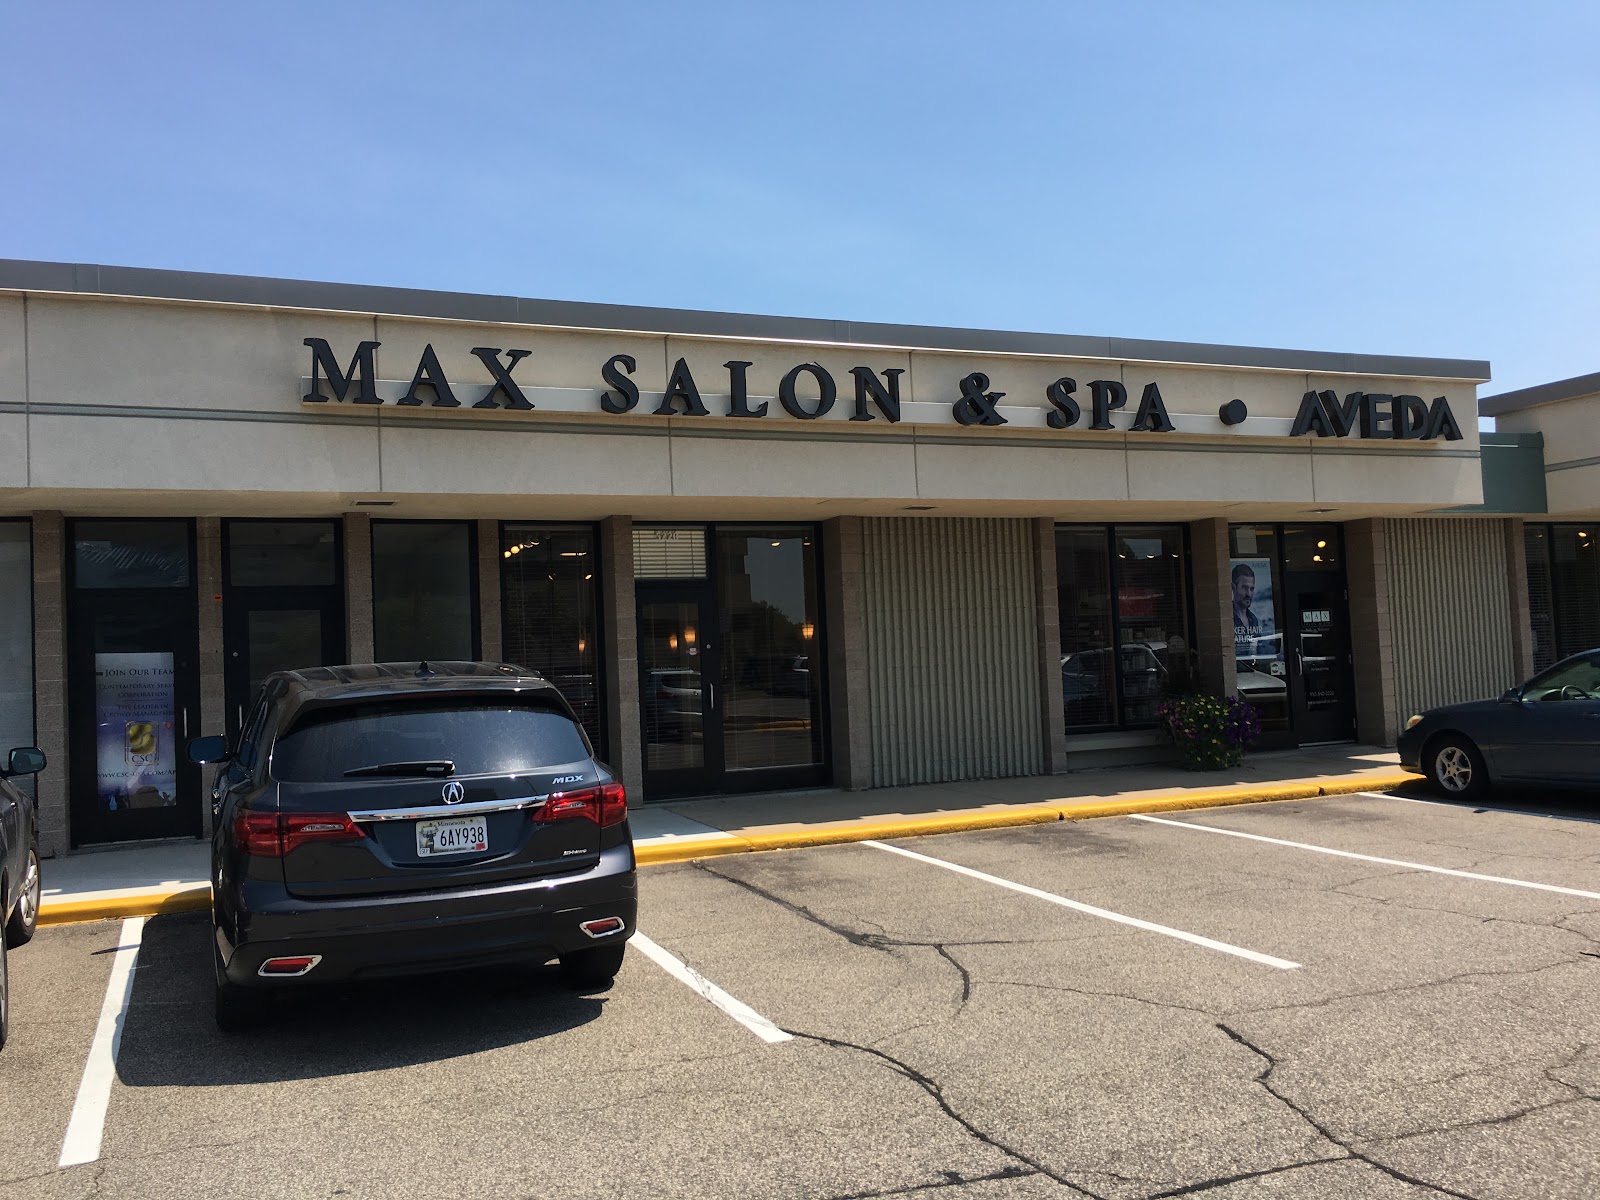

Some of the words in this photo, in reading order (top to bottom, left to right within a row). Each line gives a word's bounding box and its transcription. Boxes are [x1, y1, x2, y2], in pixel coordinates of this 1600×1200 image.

[303, 338, 536, 411] MAX
[600, 353, 905, 424] SALON
[952, 372, 1008, 427] &
[1046, 377, 1176, 433] SPA
[1289, 390, 1464, 441] AVEDA
[1304, 612, 1328, 620] MAX
[1247, 625, 1263, 634] HAIR
[105, 669, 126, 677] JOIN
[129, 668, 149, 676] OUR
[131, 754, 153, 764] CSC
[552, 775, 583, 784] MDX
[440, 826, 484, 847] 6AY938
